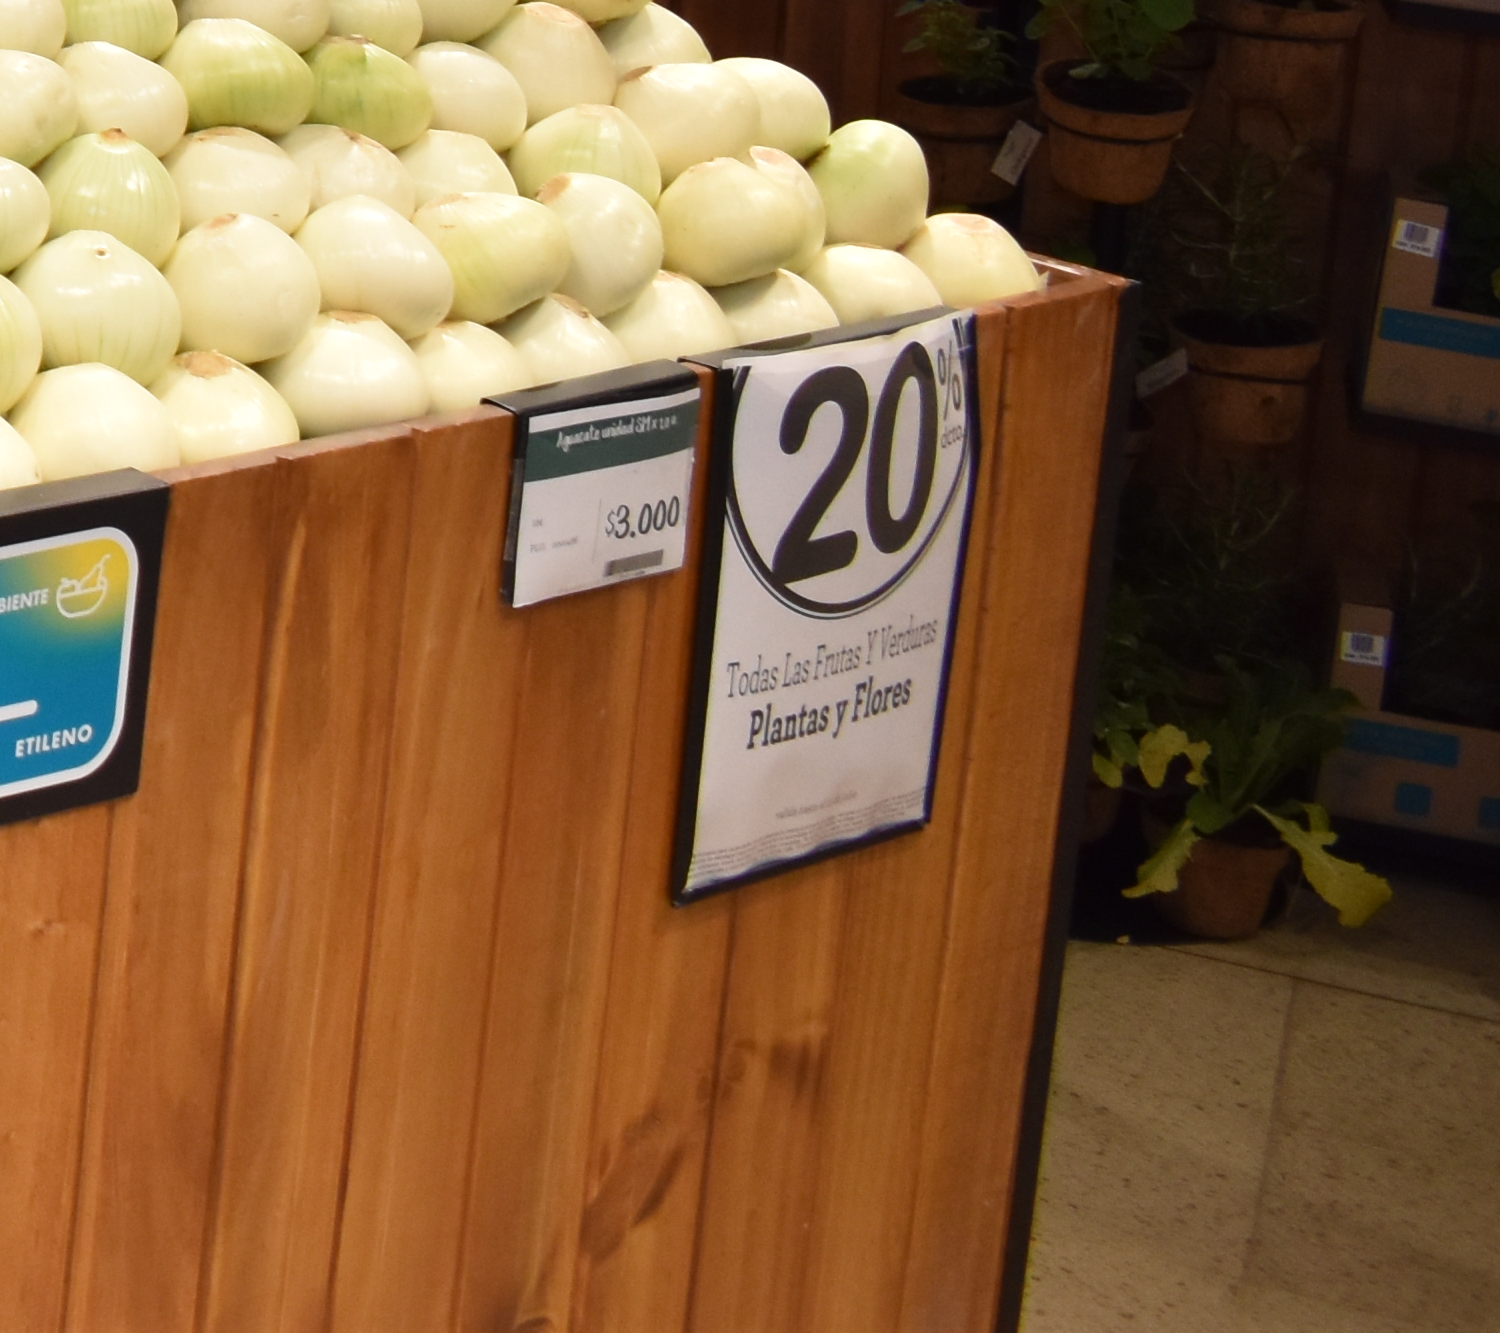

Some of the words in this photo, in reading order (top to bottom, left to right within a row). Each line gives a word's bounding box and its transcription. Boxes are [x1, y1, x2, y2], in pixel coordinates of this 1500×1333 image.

[772, 341, 939, 584] 20
[604, 494, 680, 540] $3.000
[727, 656, 778, 699] Todas
[781, 650, 810, 689] Las
[813, 639, 862, 684] Frutas
[865, 631, 879, 666] Y
[879, 615, 937, 660] Verduras
[14, 723, 93, 759] ETILENO
[746, 697, 830, 751] Plantas
[831, 697, 849, 741] y
[853, 676, 912, 723] Flores
